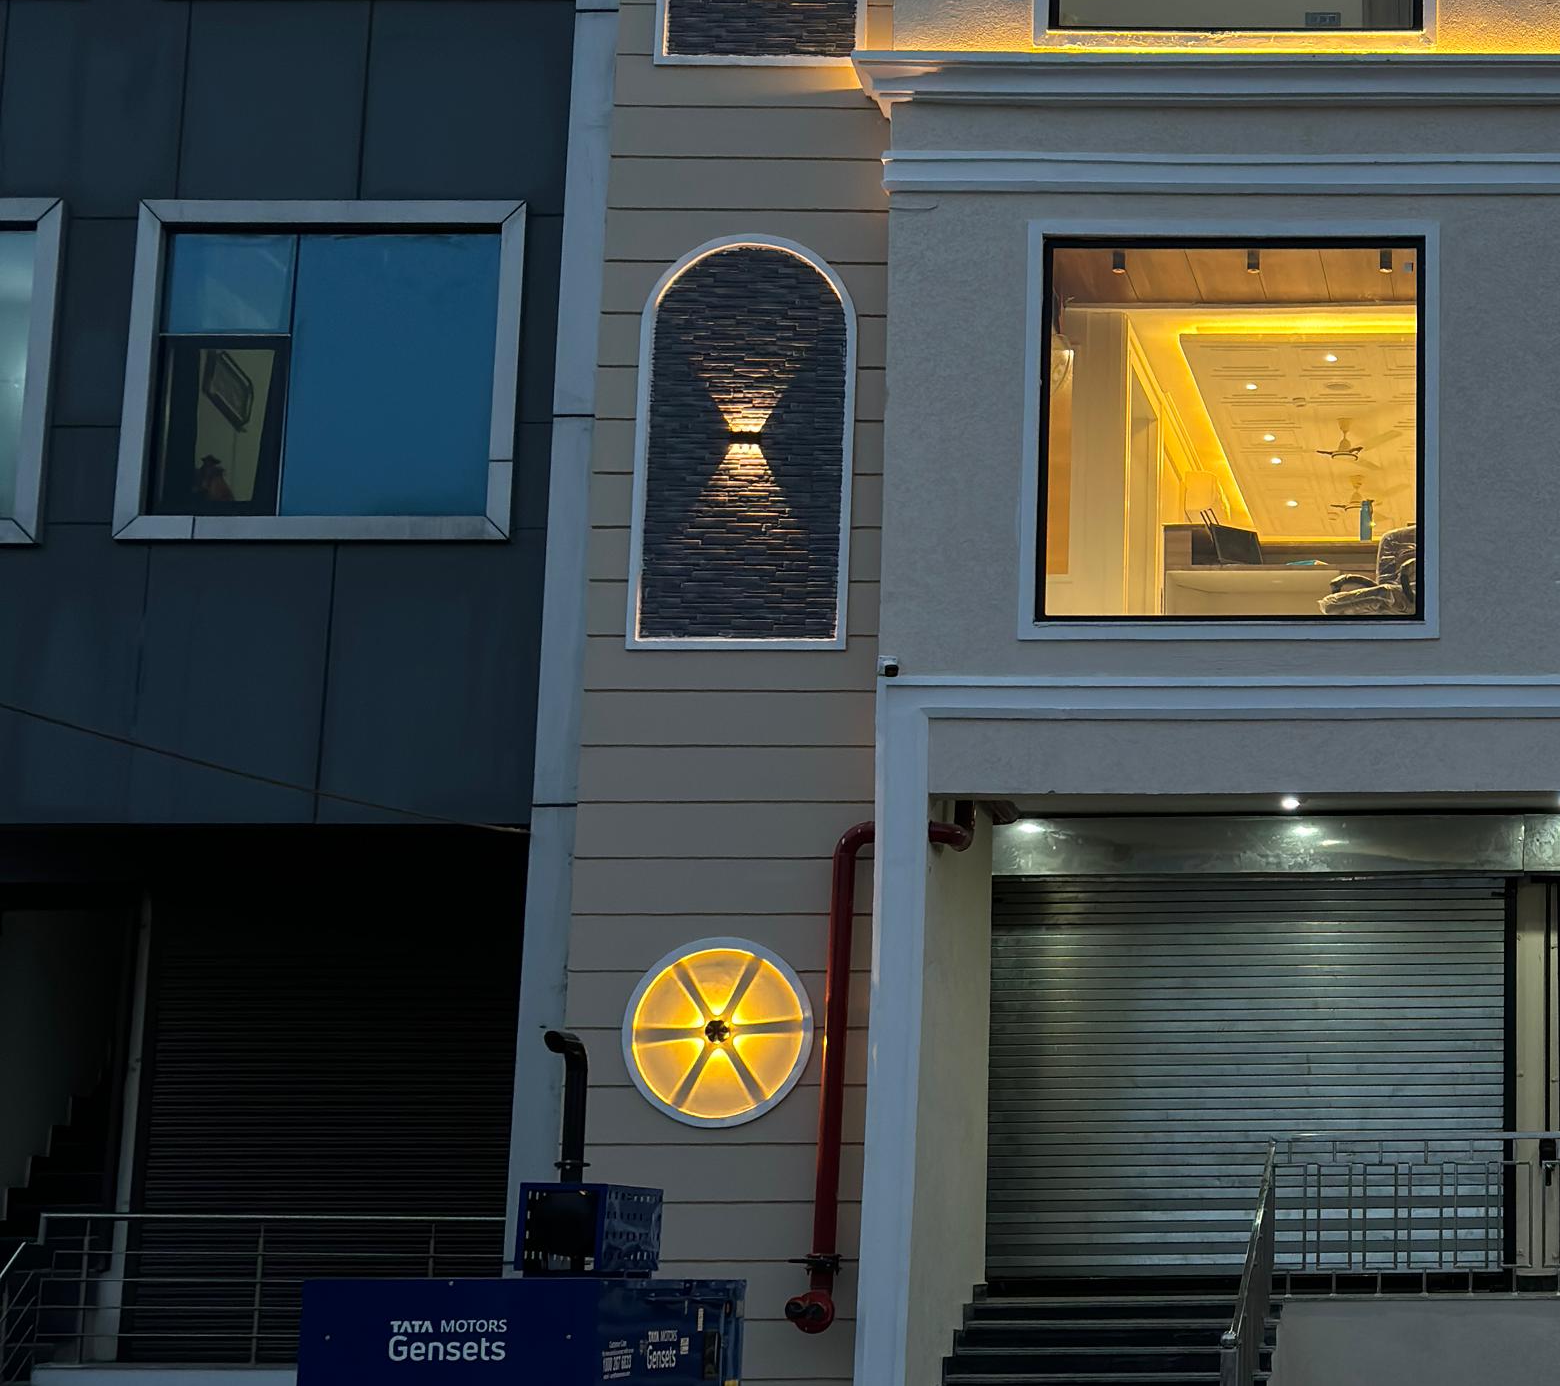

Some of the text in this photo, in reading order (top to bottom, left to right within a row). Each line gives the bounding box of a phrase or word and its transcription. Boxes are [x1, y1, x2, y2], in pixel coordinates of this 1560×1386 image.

[389, 1319, 508, 1334] TATA MOTORS
[388, 1335, 507, 1362] Gensets
[647, 1344, 676, 1370] Gensets
